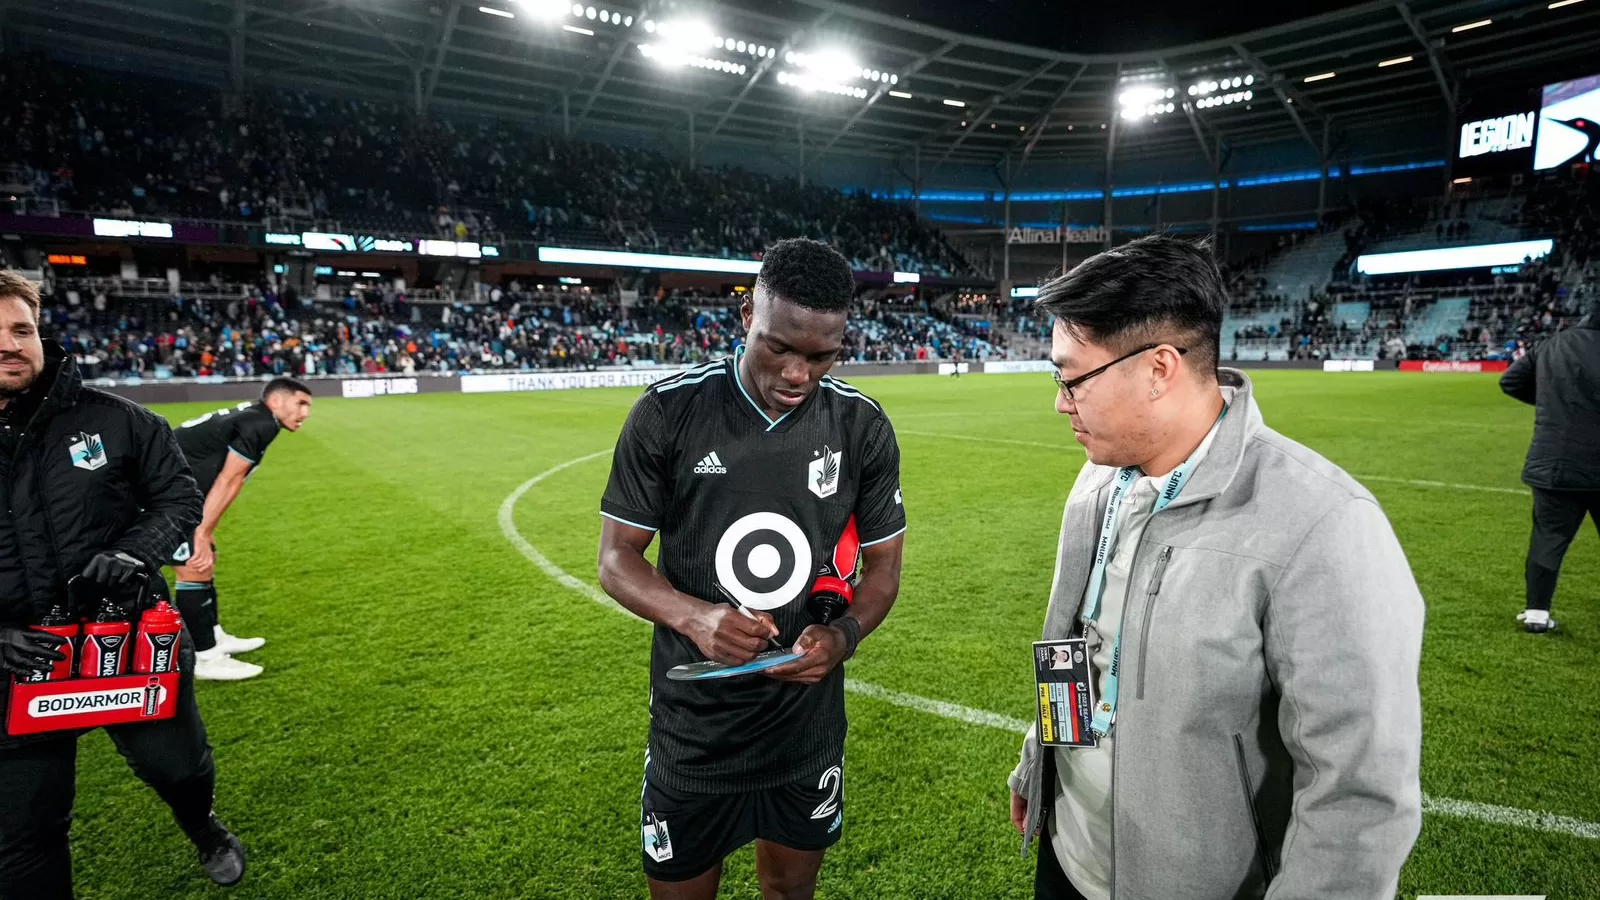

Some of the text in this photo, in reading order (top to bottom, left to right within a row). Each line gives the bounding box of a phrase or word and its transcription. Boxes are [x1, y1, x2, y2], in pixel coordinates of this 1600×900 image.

[1008, 226, 1111, 244] Allina Health
[508, 377, 555, 392] THANK
[557, 376, 586, 389] YOU
[590, 375, 616, 388] FOR
[693, 465, 728, 475] adidas
[1163, 470, 1183, 500] MNUFC
[1097, 536, 1108, 565] MNUFC
[37, 691, 142, 713] BODYARMOR
[810, 764, 842, 820] 2
